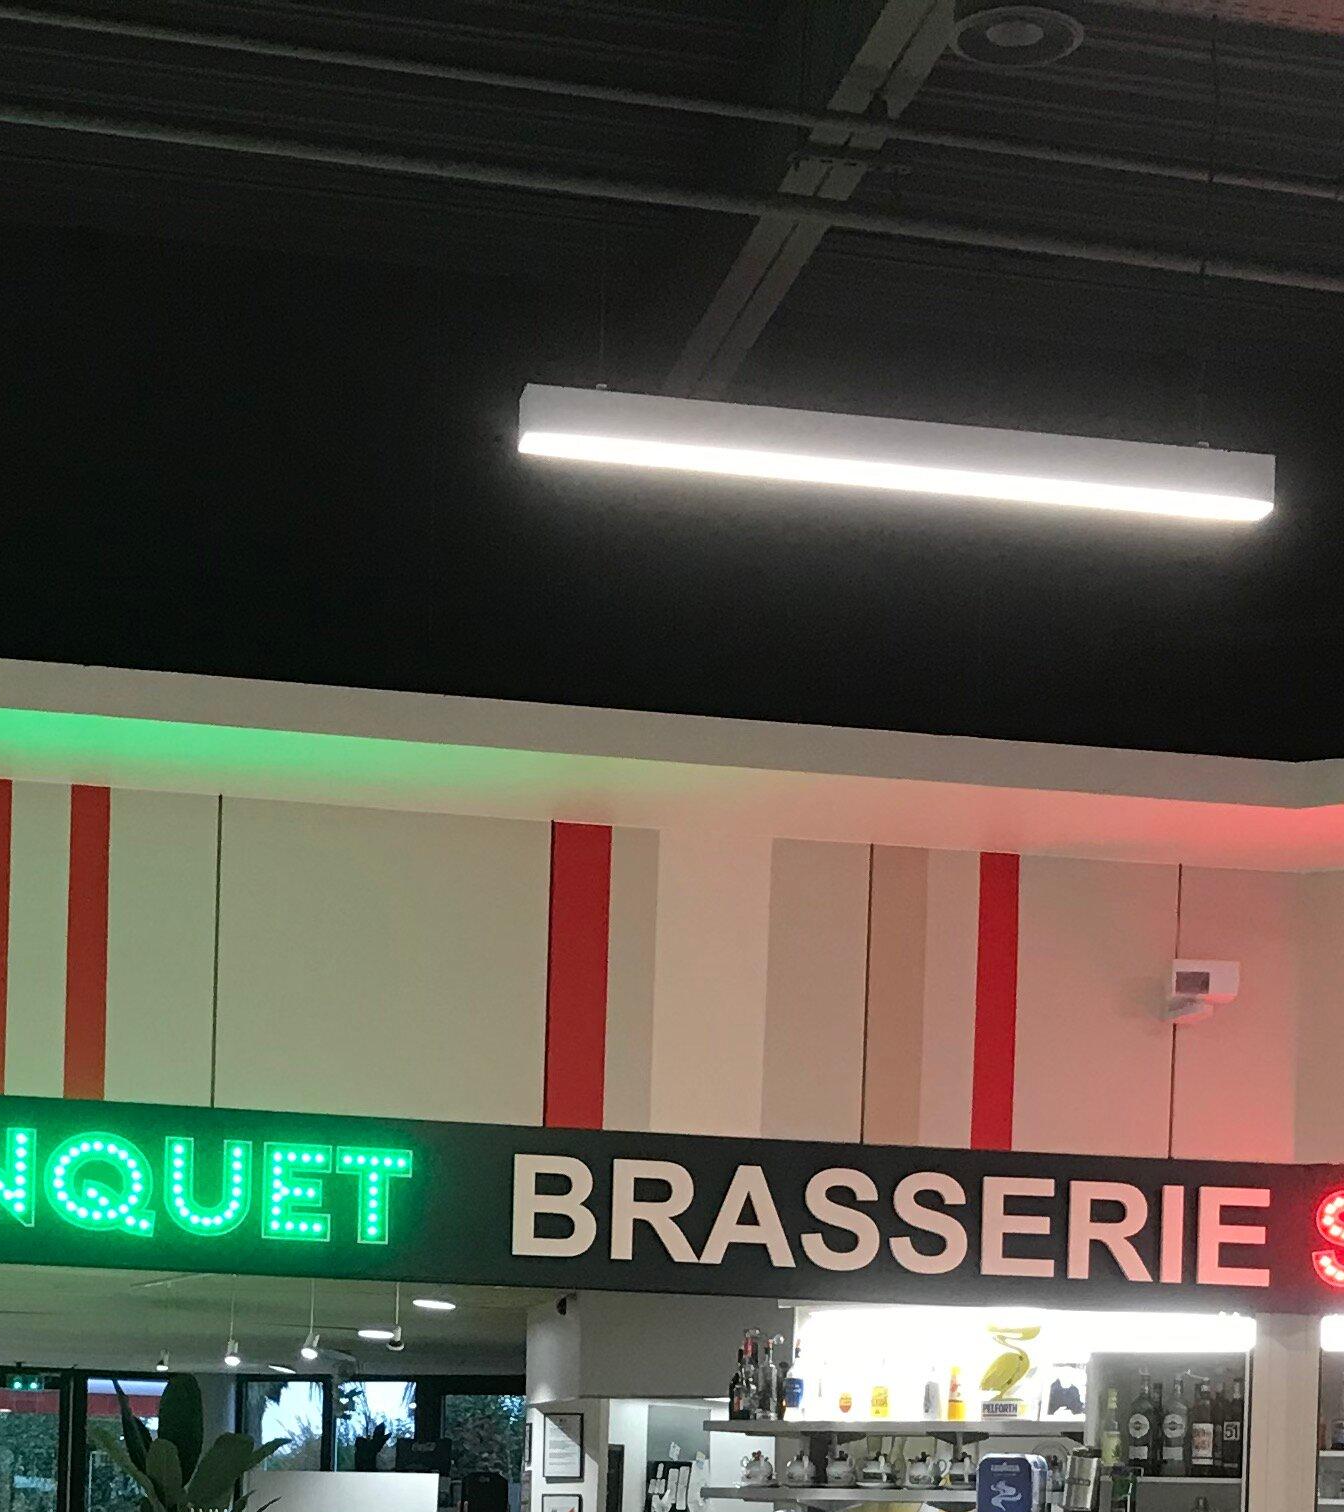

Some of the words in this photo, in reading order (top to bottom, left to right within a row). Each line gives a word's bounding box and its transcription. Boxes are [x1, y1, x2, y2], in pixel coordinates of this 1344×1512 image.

[510, 1152, 1271, 1287] BRASSERIE
[982, 1403, 1018, 1414] PELFORTH
[1225, 1425, 1239, 1439] 51
